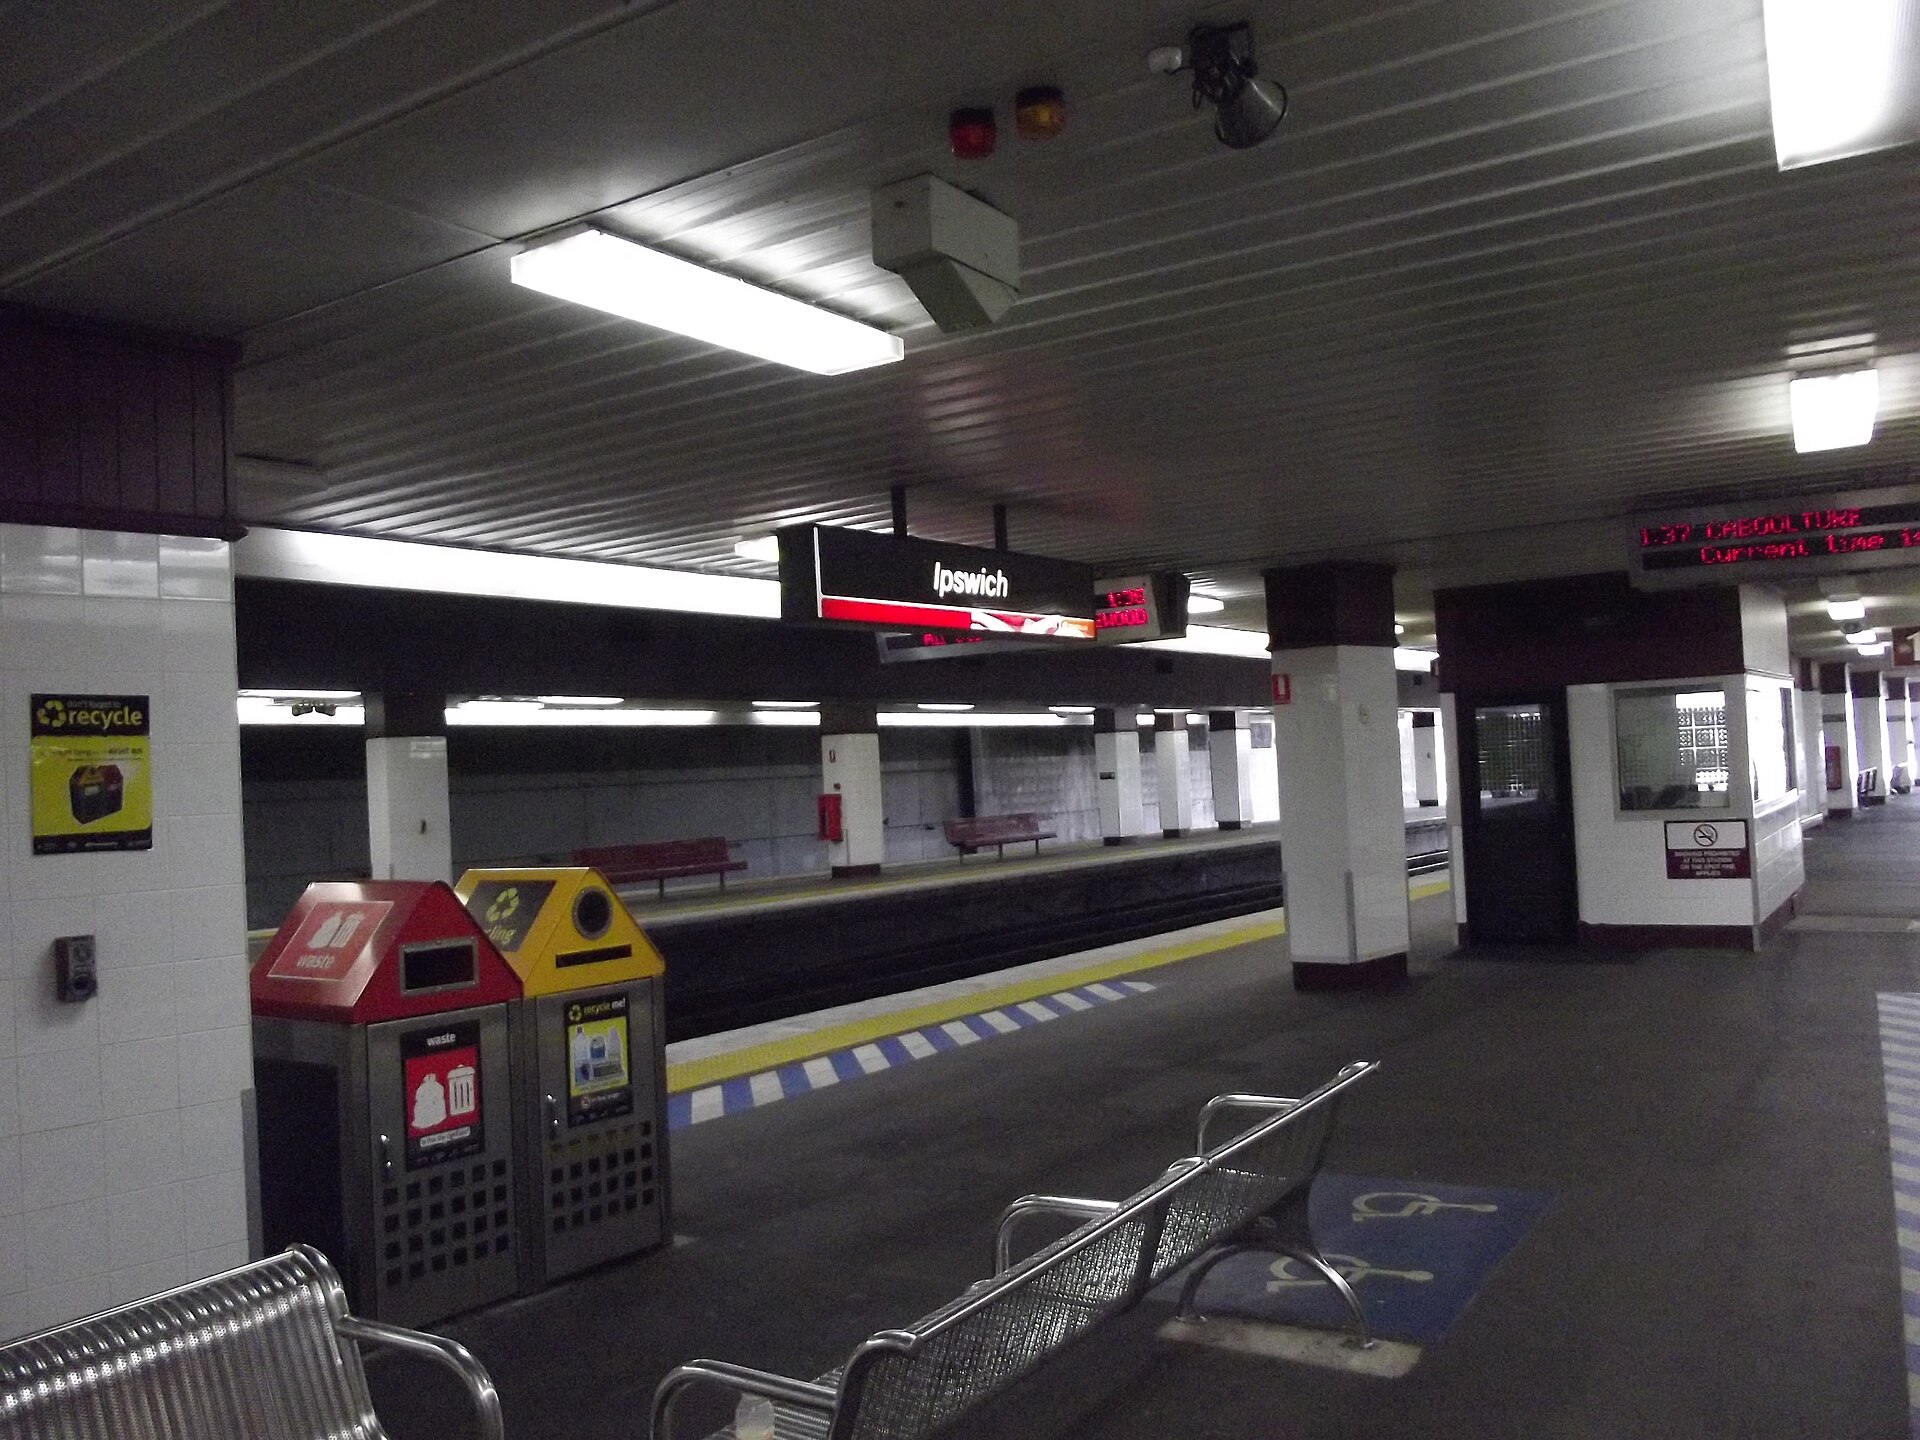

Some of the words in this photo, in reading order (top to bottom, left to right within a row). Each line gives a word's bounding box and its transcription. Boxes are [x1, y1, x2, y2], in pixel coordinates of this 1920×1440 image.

[1705, 507, 1860, 538] CABOOLTURE
[1699, 537, 1809, 565] Current
[1824, 531, 1885, 554] time
[933, 561, 1009, 598] Ipswich
[69, 706, 142, 729] recycle
[296, 953, 336, 968] waste
[583, 1001, 610, 1015] recycle
[427, 1033, 457, 1046] waste
